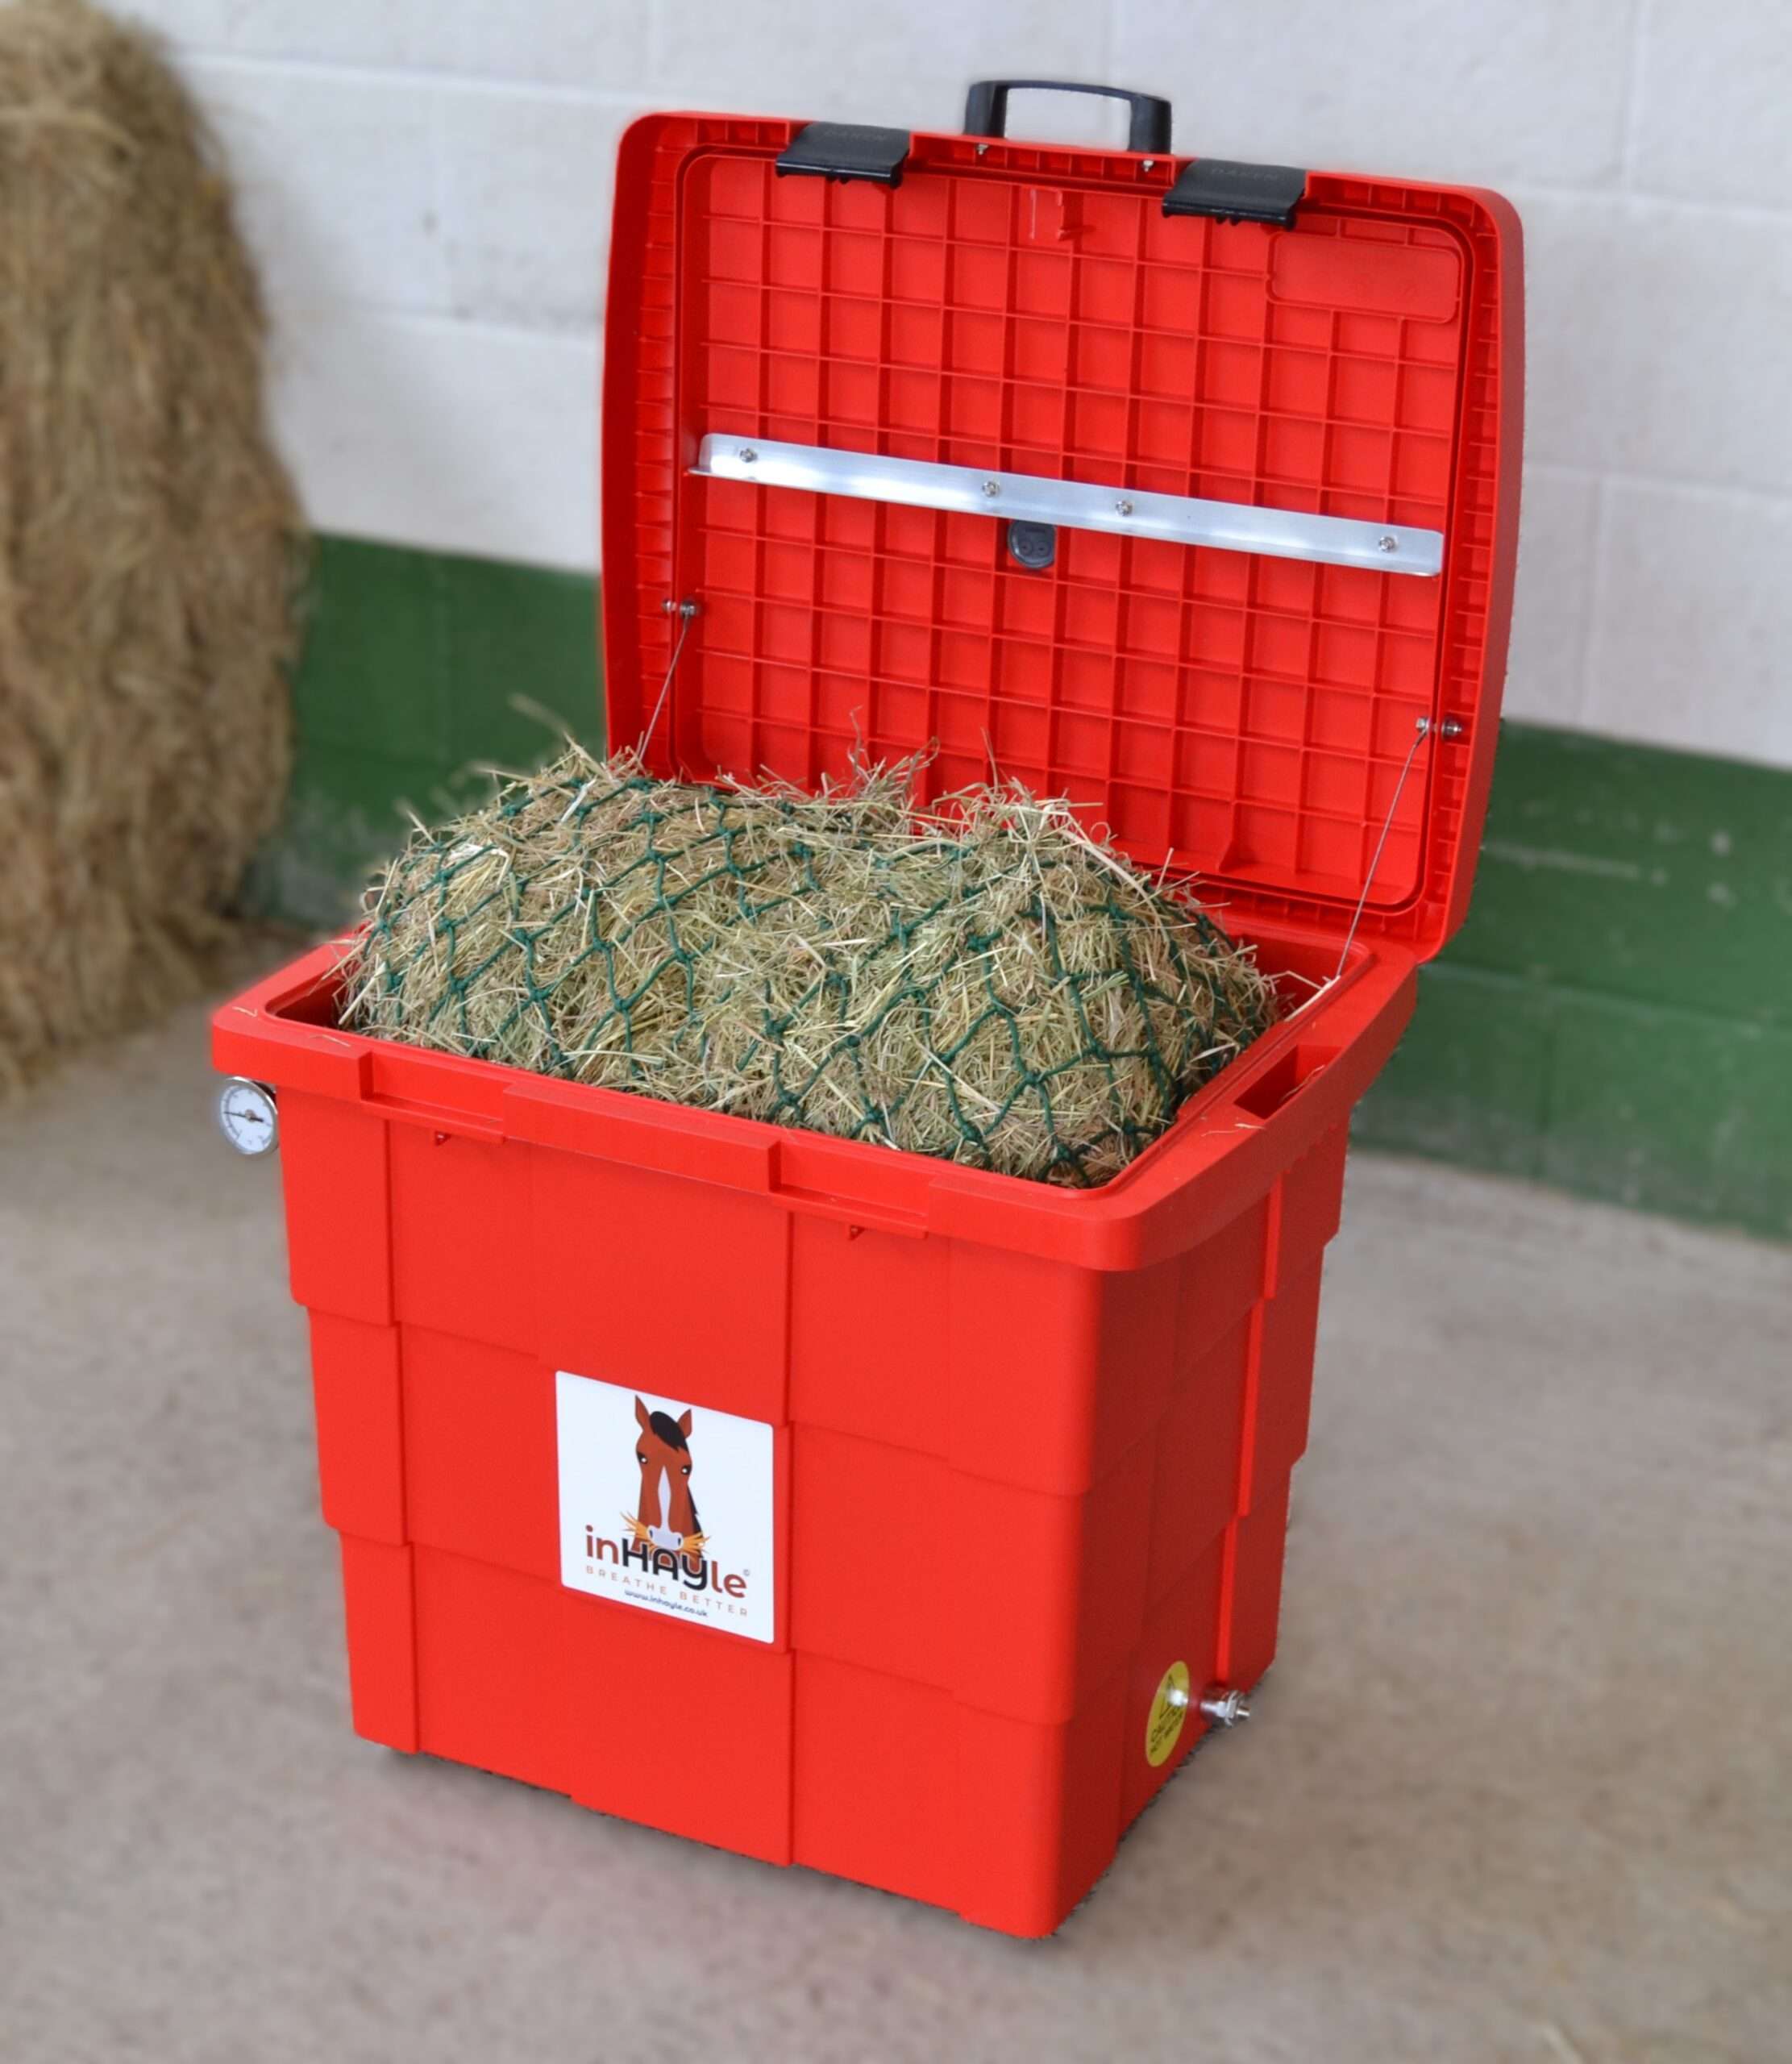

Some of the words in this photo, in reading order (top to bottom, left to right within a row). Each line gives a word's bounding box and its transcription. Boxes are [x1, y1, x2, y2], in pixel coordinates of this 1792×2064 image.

[586, 1565, 667, 1596] BREATHE
[680, 1591, 748, 1617] BETTER
[624, 1588, 709, 1617] www.inhayle.co.uk
